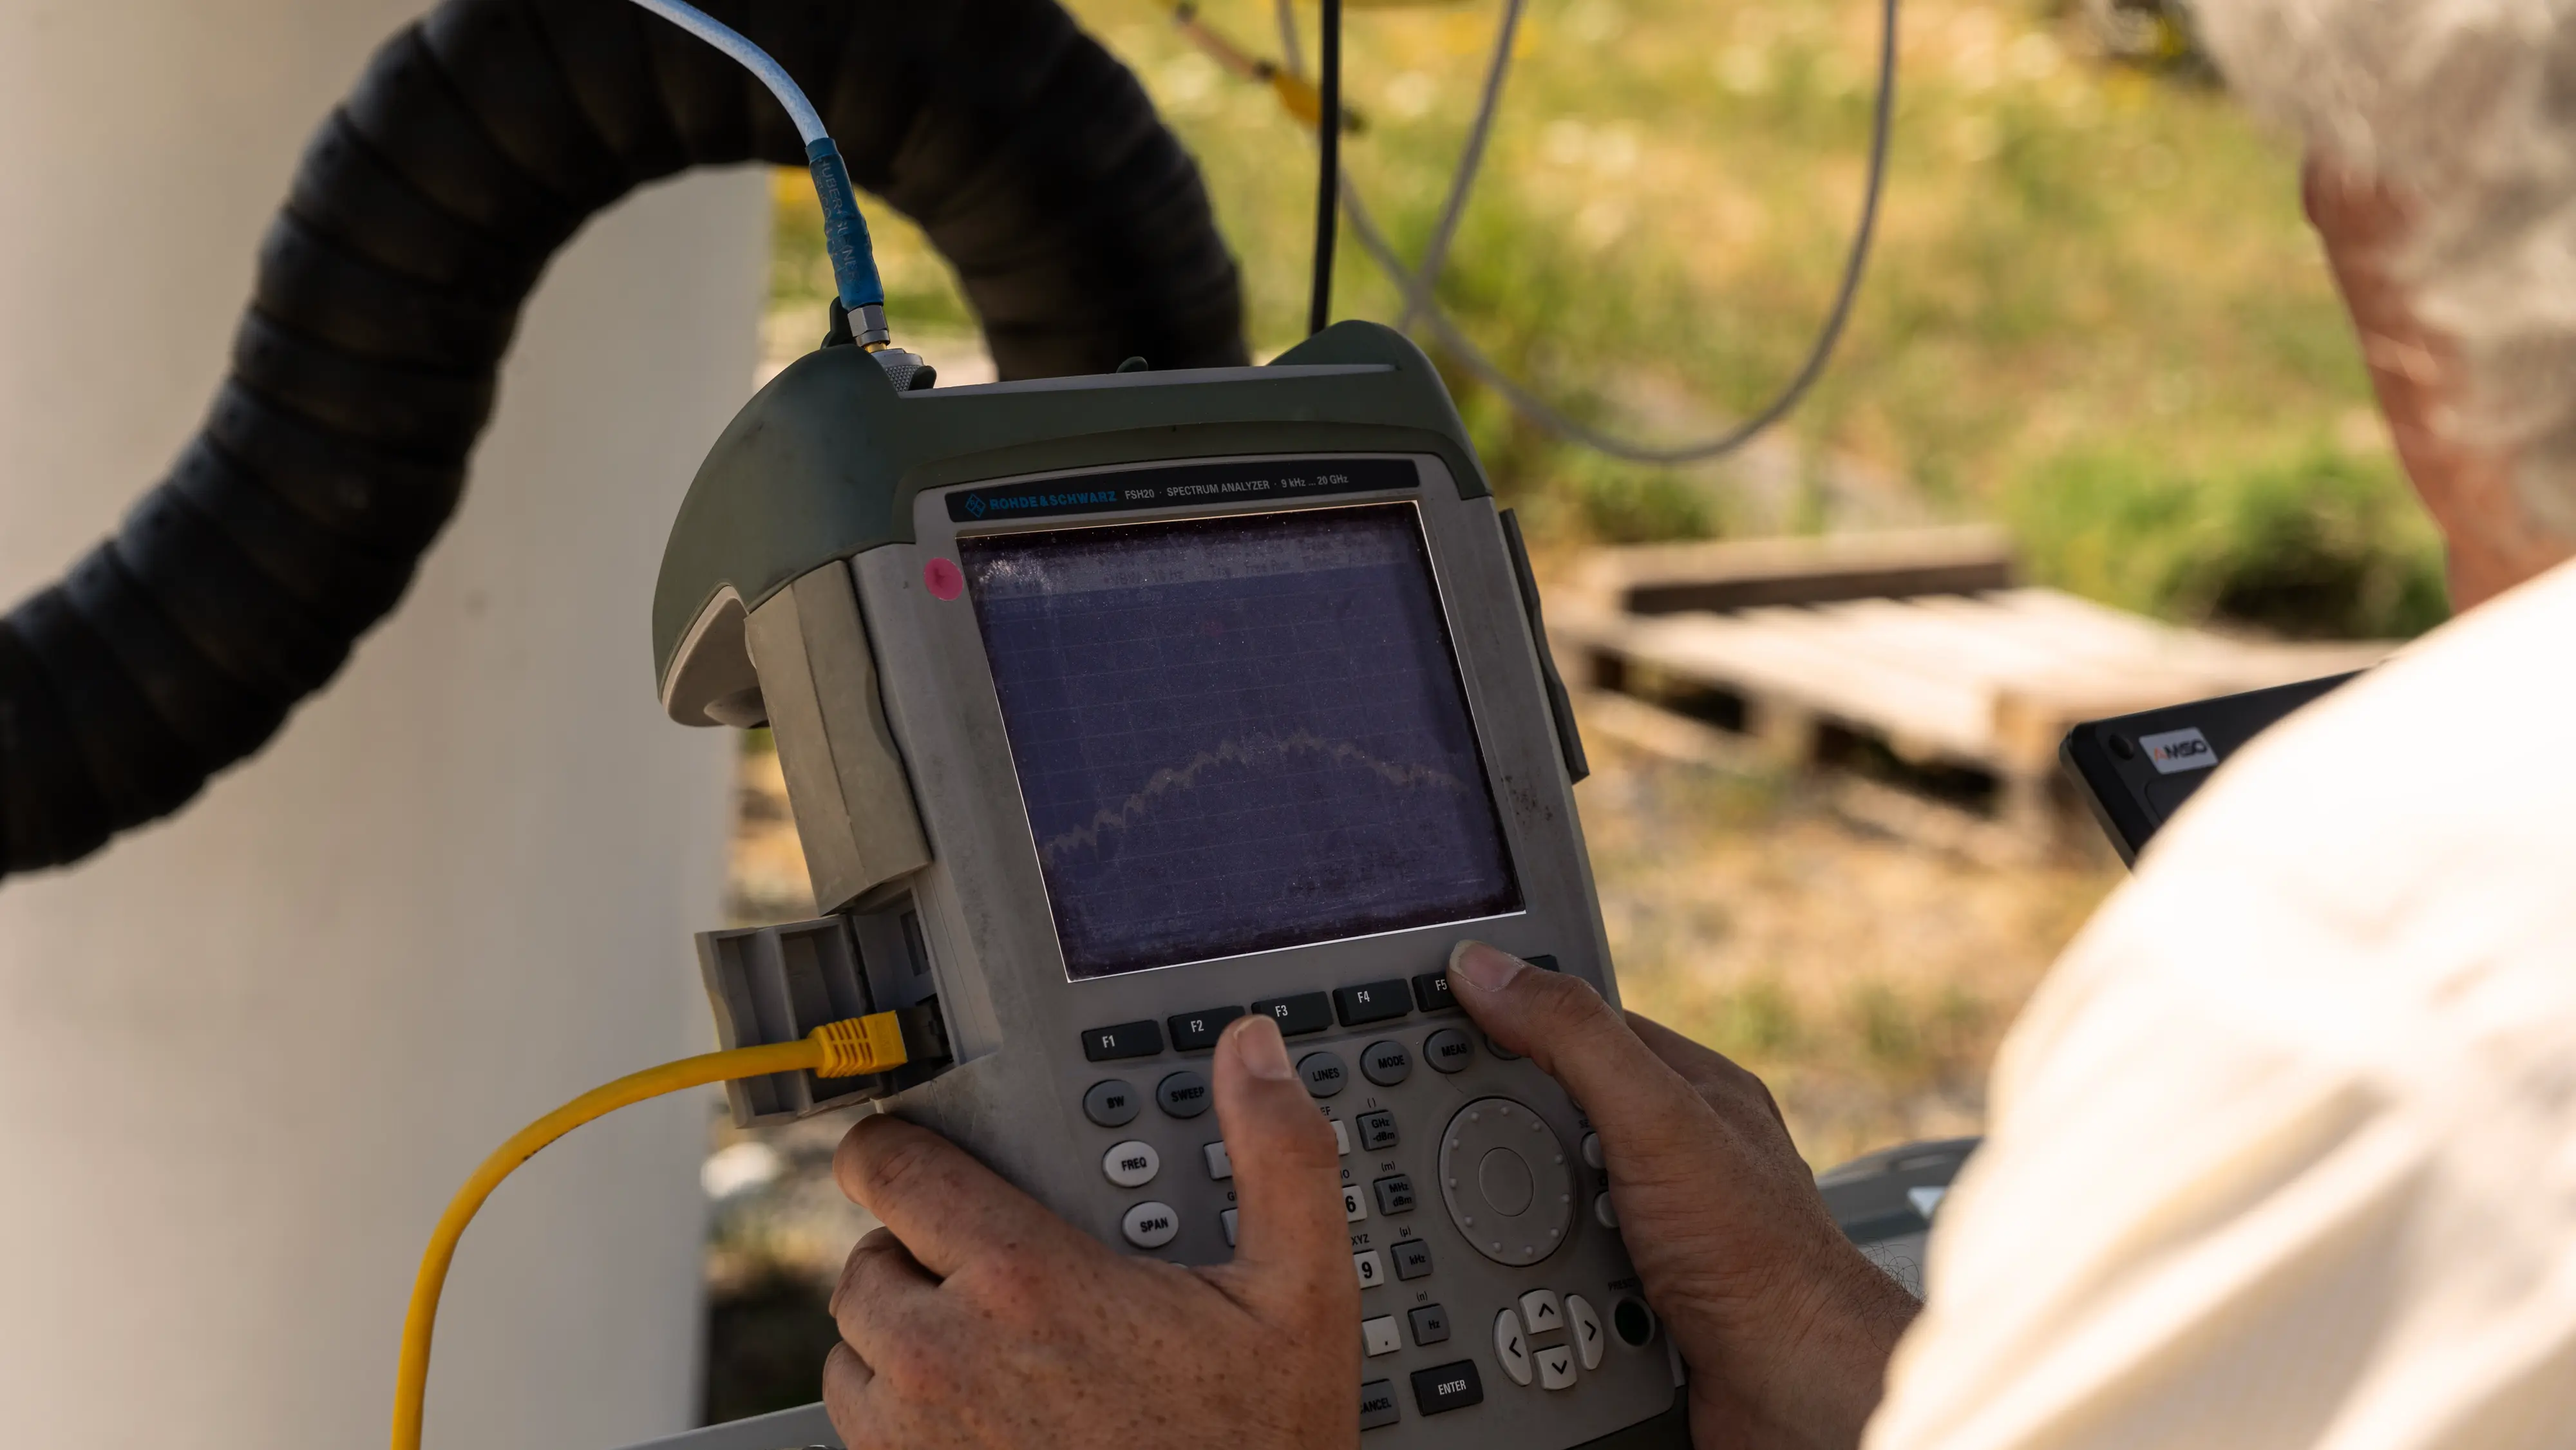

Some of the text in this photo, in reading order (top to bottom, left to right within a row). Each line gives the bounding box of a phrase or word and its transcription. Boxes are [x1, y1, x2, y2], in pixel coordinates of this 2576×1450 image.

[1124, 489, 1155, 500] FSH20
[1166, 484, 1219, 497] SPECTRUM
[1221, 480, 1271, 493] ANALYZER
[1281, 479, 1287, 488] 9
[1289, 478, 1305, 487] kHz
[1317, 475, 1329, 485] 20
[1330, 474, 1349, 484] GHz
[1435, 979, 1447, 991] F5
[1357, 990, 1370, 1003] F4
[1275, 1004, 1289, 1017] F3
[1190, 1019, 1204, 1033] F2
[1102, 1035, 1115, 1048] F1
[1441, 1042, 1468, 1057] MEAS
[1378, 1055, 1405, 1069] MODE
[1312, 1068, 1340, 1082] LINES
[1170, 1086, 1204, 1102] SWEEP
[1106, 1095, 1124, 1109] BW
[1371, 1118, 1390, 1128] GHz
[1373, 1131, 1395, 1142] -dBm
[1121, 1156, 1148, 1171] FREQ
[1381, 1161, 1396, 1172] (m)
[1388, 1182, 1409, 1193] MHz
[1345, 1195, 1356, 1212] 6
[1393, 1196, 1412, 1207] dBm
[1140, 1217, 1168, 1233] SPAN
[1409, 1253, 1426, 1265] kHz
[1361, 1261, 1373, 1279] 9
[1416, 1291, 1428, 1303] (n)
[1428, 1319, 1441, 1330] Hz
[1437, 1379, 1467, 1395] ENTER
